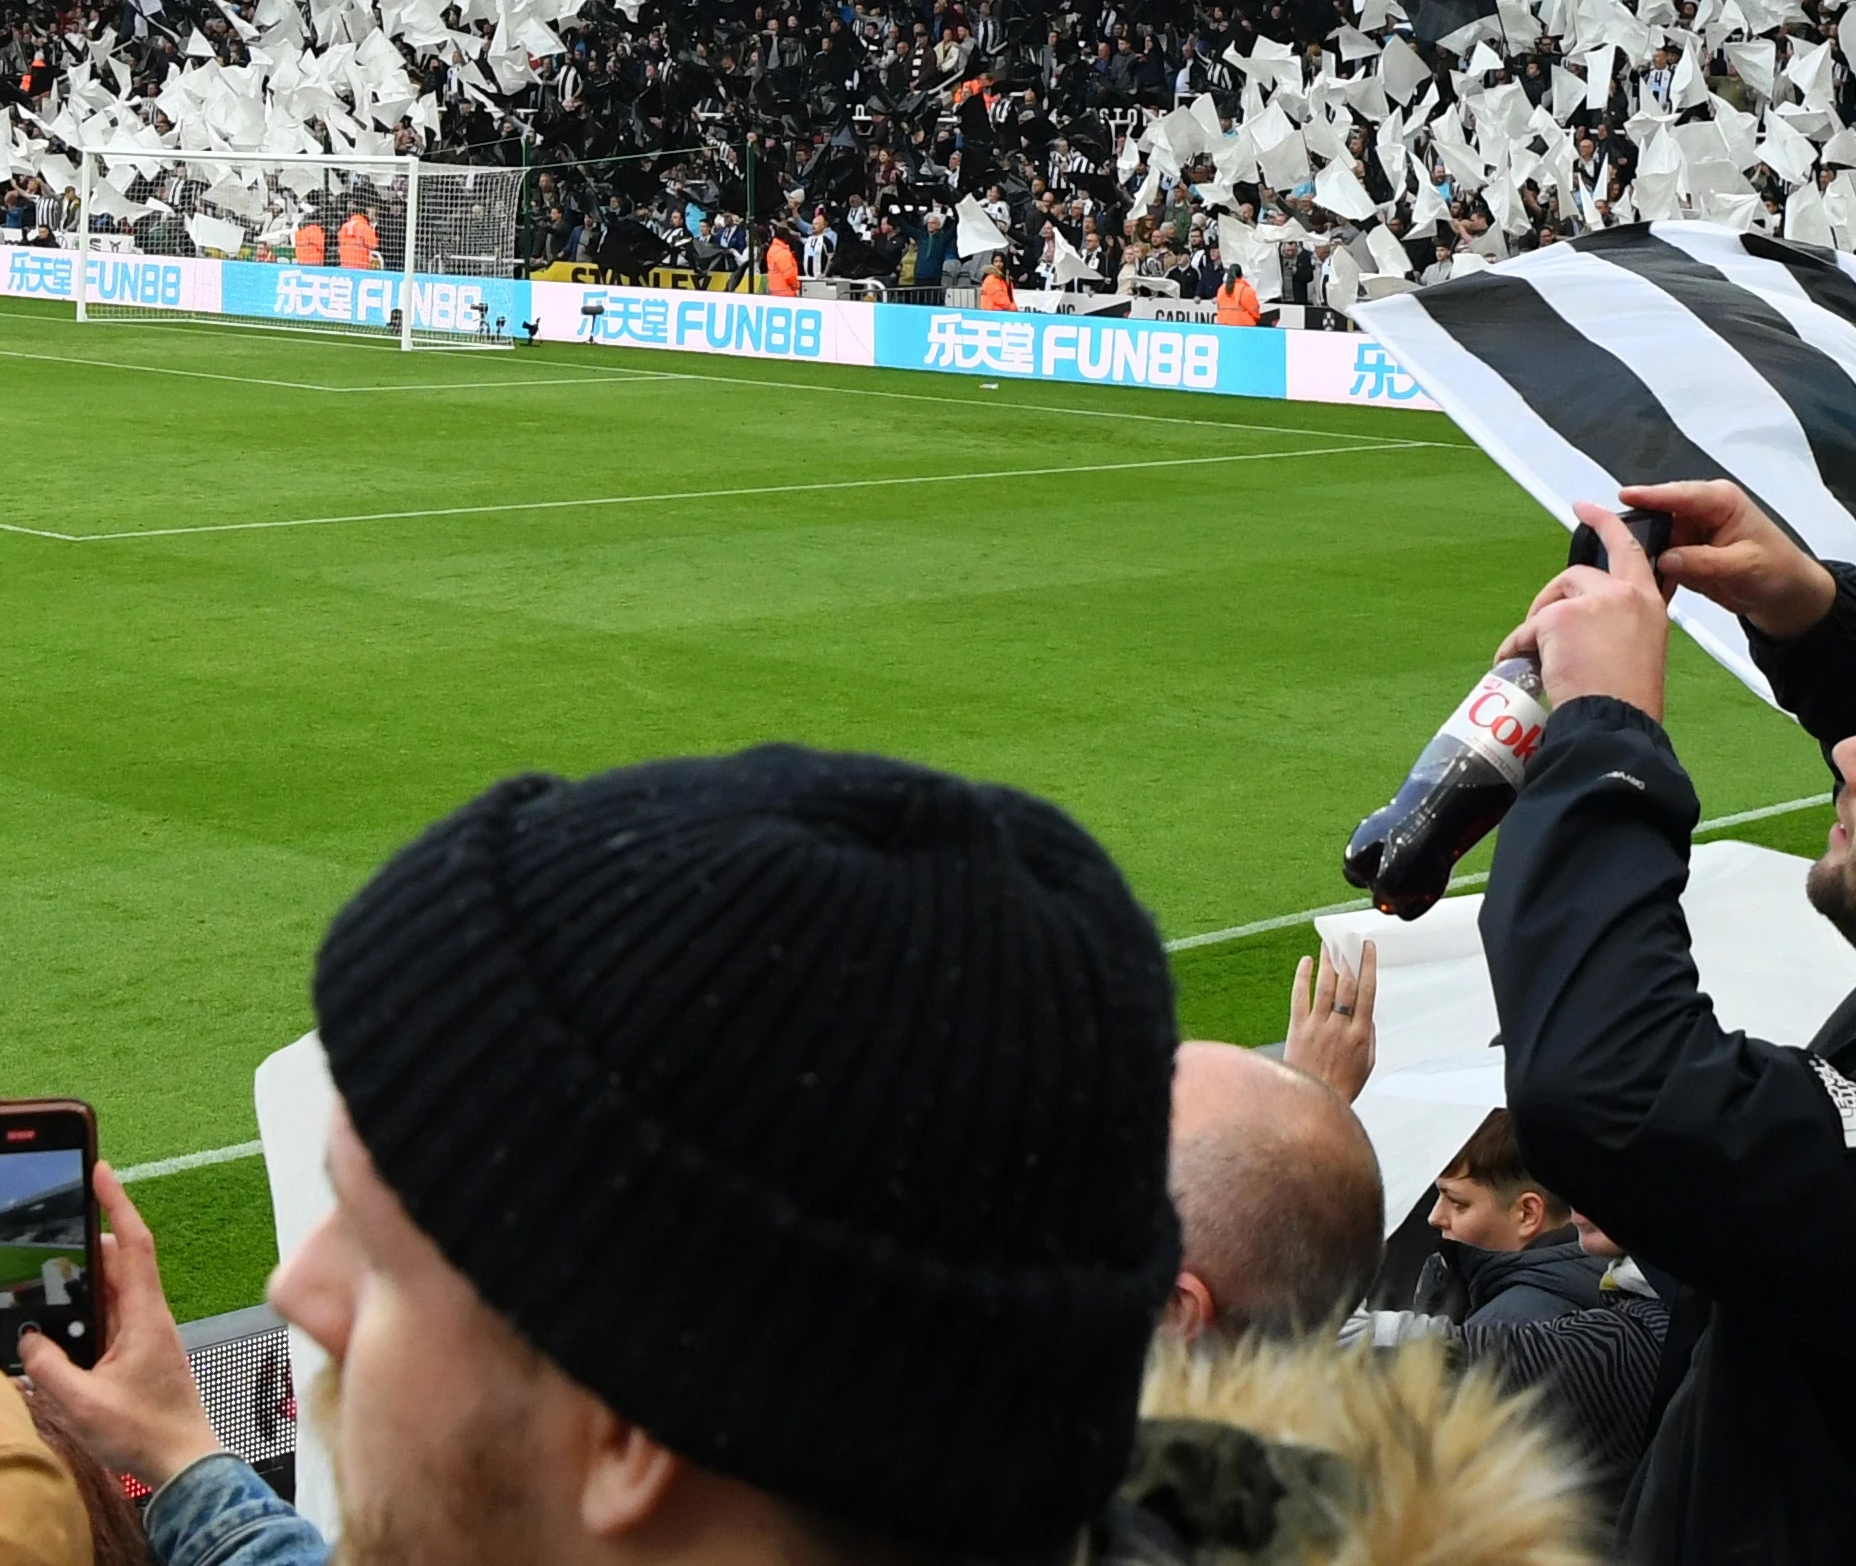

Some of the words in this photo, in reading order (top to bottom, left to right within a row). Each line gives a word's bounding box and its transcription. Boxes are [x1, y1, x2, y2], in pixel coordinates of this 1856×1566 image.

[676, 301, 823, 357] FUN88
[1041, 324, 1219, 389] FUN88
[1469, 692, 1542, 764] Cok
